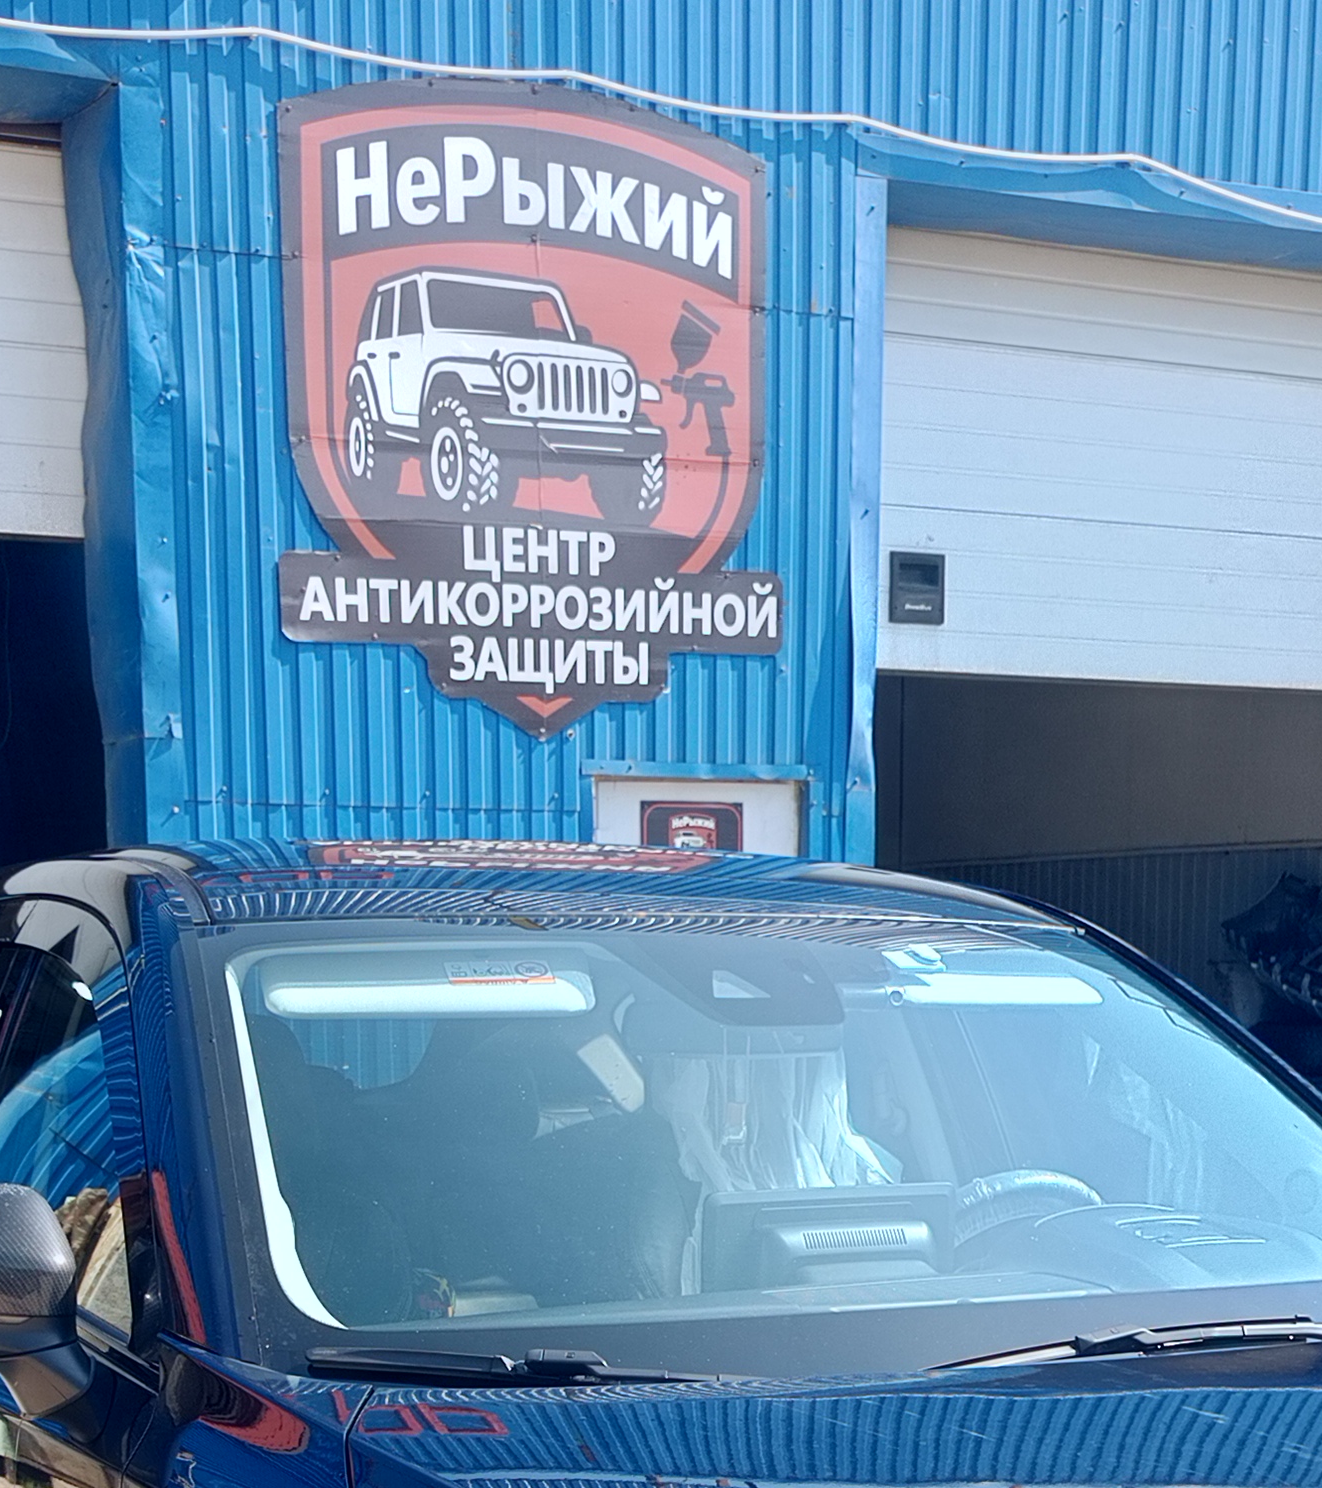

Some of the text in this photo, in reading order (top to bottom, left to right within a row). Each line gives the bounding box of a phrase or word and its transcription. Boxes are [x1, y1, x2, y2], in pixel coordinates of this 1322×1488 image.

[335, 136, 733, 280] НеРыжий
[462, 524, 616, 582] ЦЕНТР
[299, 576, 778, 639] АНТИКОРРОЗИЙНОЙ
[449, 636, 650, 693] ЗАЩИТЫ
